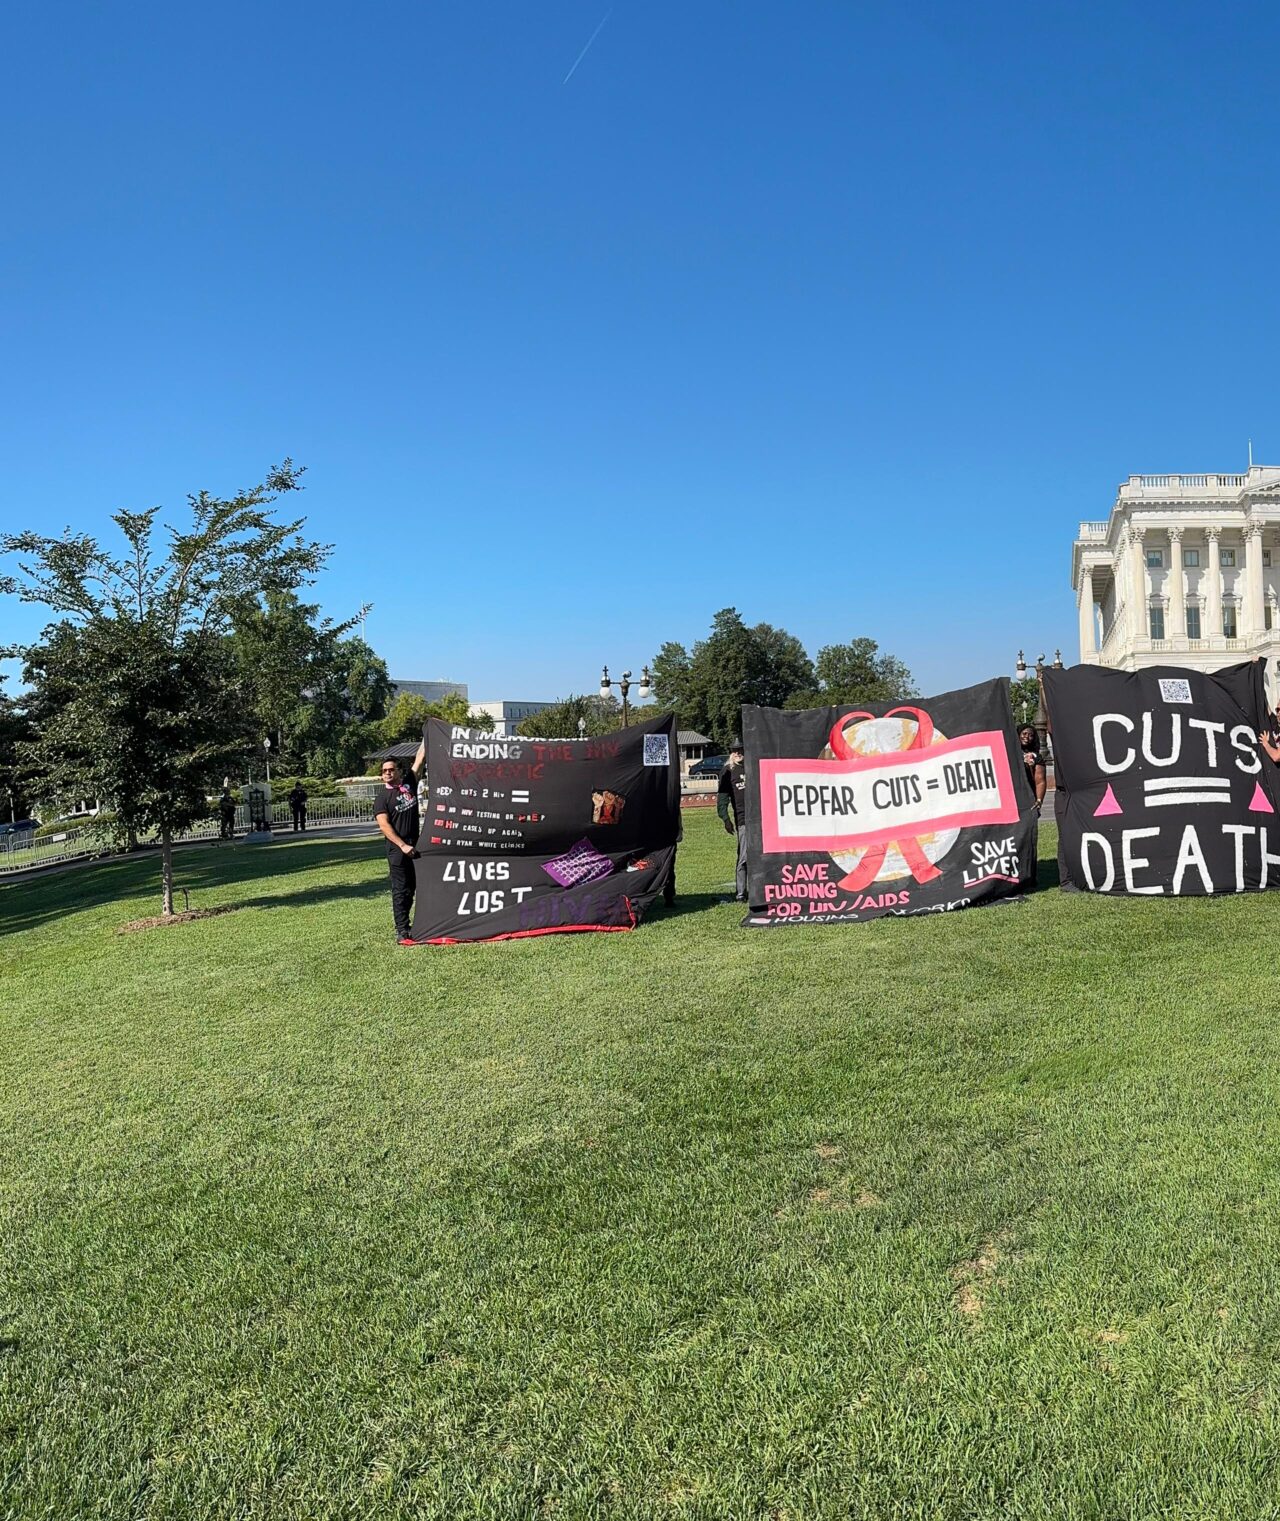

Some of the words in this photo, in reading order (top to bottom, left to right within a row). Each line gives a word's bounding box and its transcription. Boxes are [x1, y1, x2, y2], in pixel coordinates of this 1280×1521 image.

[451, 726, 471, 740] IN
[1092, 712, 1262, 774] CUTS
[452, 744, 522, 760] ENDING
[461, 789, 477, 797] CUTS
[482, 789, 489, 798] 2
[779, 785, 858, 817] PEPFAR
[872, 774, 922, 810] CUTS
[927, 778, 939, 790] =
[943, 758, 997, 795] DEATH
[461, 808, 473, 816] HIV
[476, 811, 501, 820] TESTING
[970, 836, 1017, 866] SAVE
[442, 860, 510, 883] LIVES
[781, 863, 829, 884] SAVE
[962, 855, 1019, 885] LIVES
[457, 886, 533, 915] LOST
[764, 882, 838, 902] FUNDING
[767, 903, 801, 918] FOR
